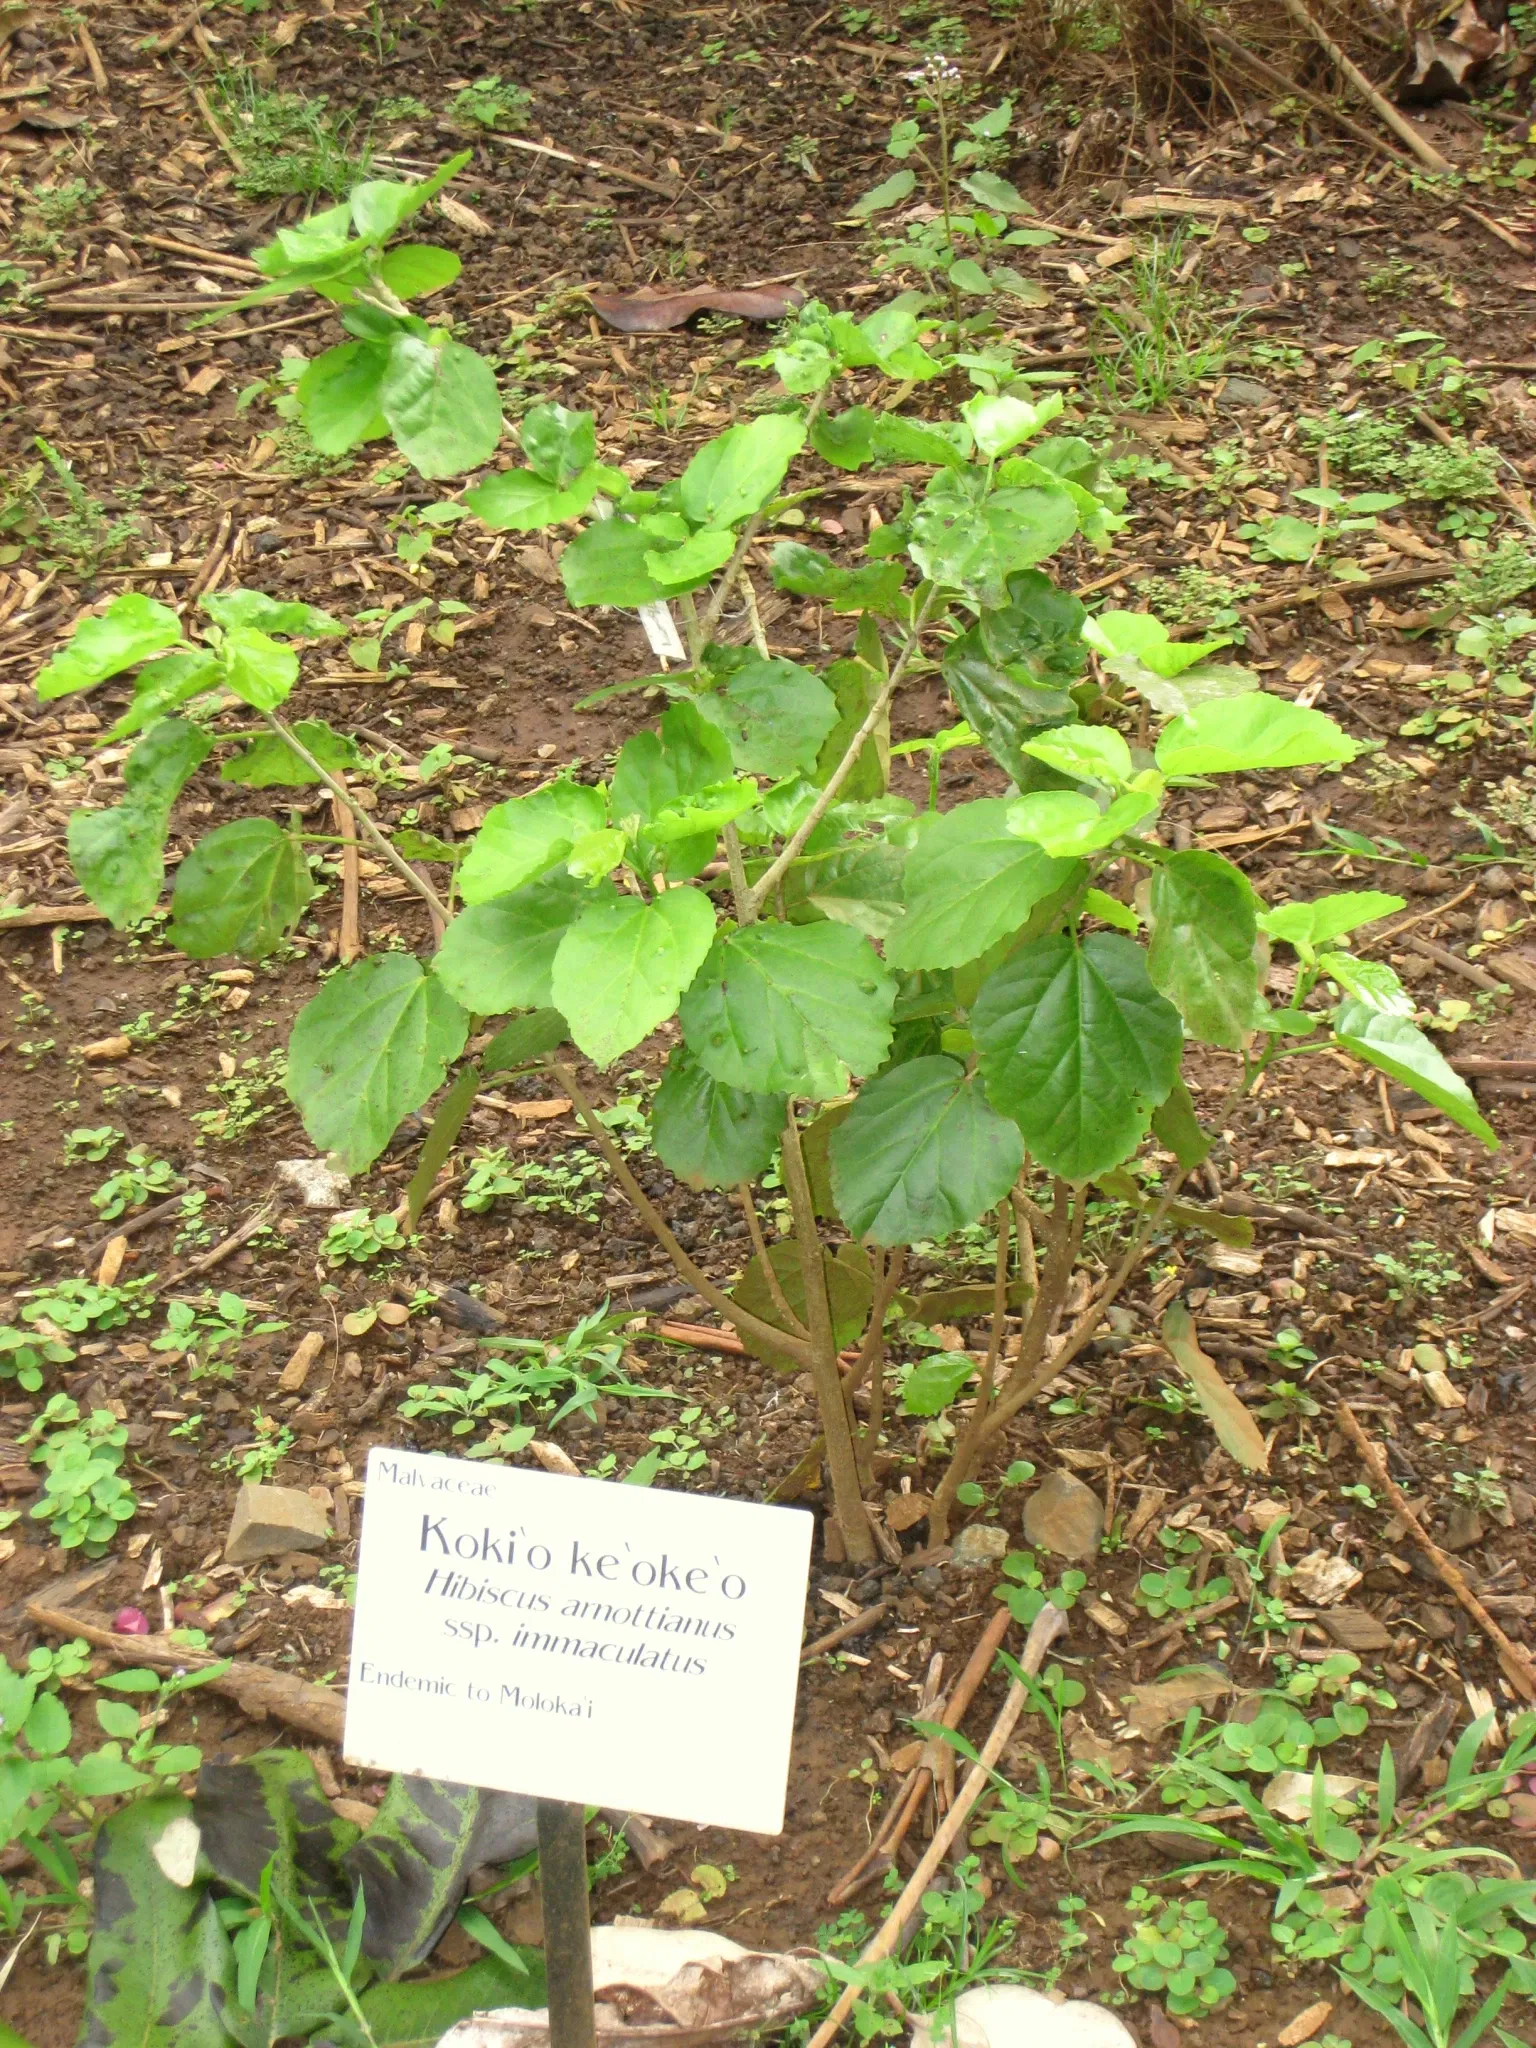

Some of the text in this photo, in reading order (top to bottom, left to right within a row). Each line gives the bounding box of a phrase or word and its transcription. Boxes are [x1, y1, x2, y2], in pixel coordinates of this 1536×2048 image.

[423, 1567, 737, 1641] Hibiscus arnottianus
[443, 1618, 708, 1676] ssp. immaculatus
[359, 1661, 457, 1697] Endemic
[467, 1682, 490, 1702] to
